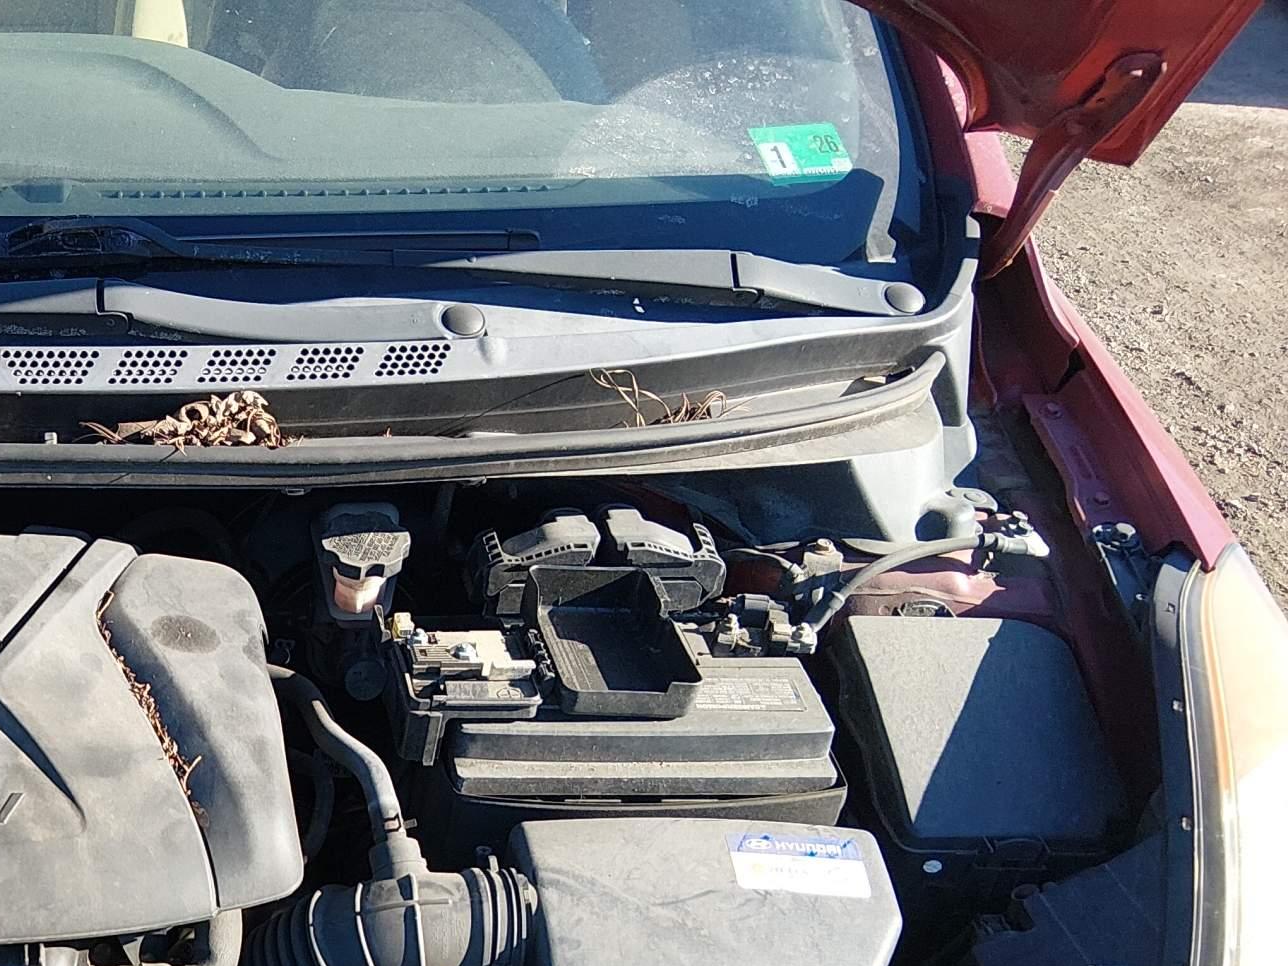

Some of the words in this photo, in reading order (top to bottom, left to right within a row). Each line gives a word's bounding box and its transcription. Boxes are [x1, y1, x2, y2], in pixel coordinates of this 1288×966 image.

[812, 133, 840, 154] 26
[769, 145, 788, 169] 1
[775, 840, 842, 855] HYUNDAI
